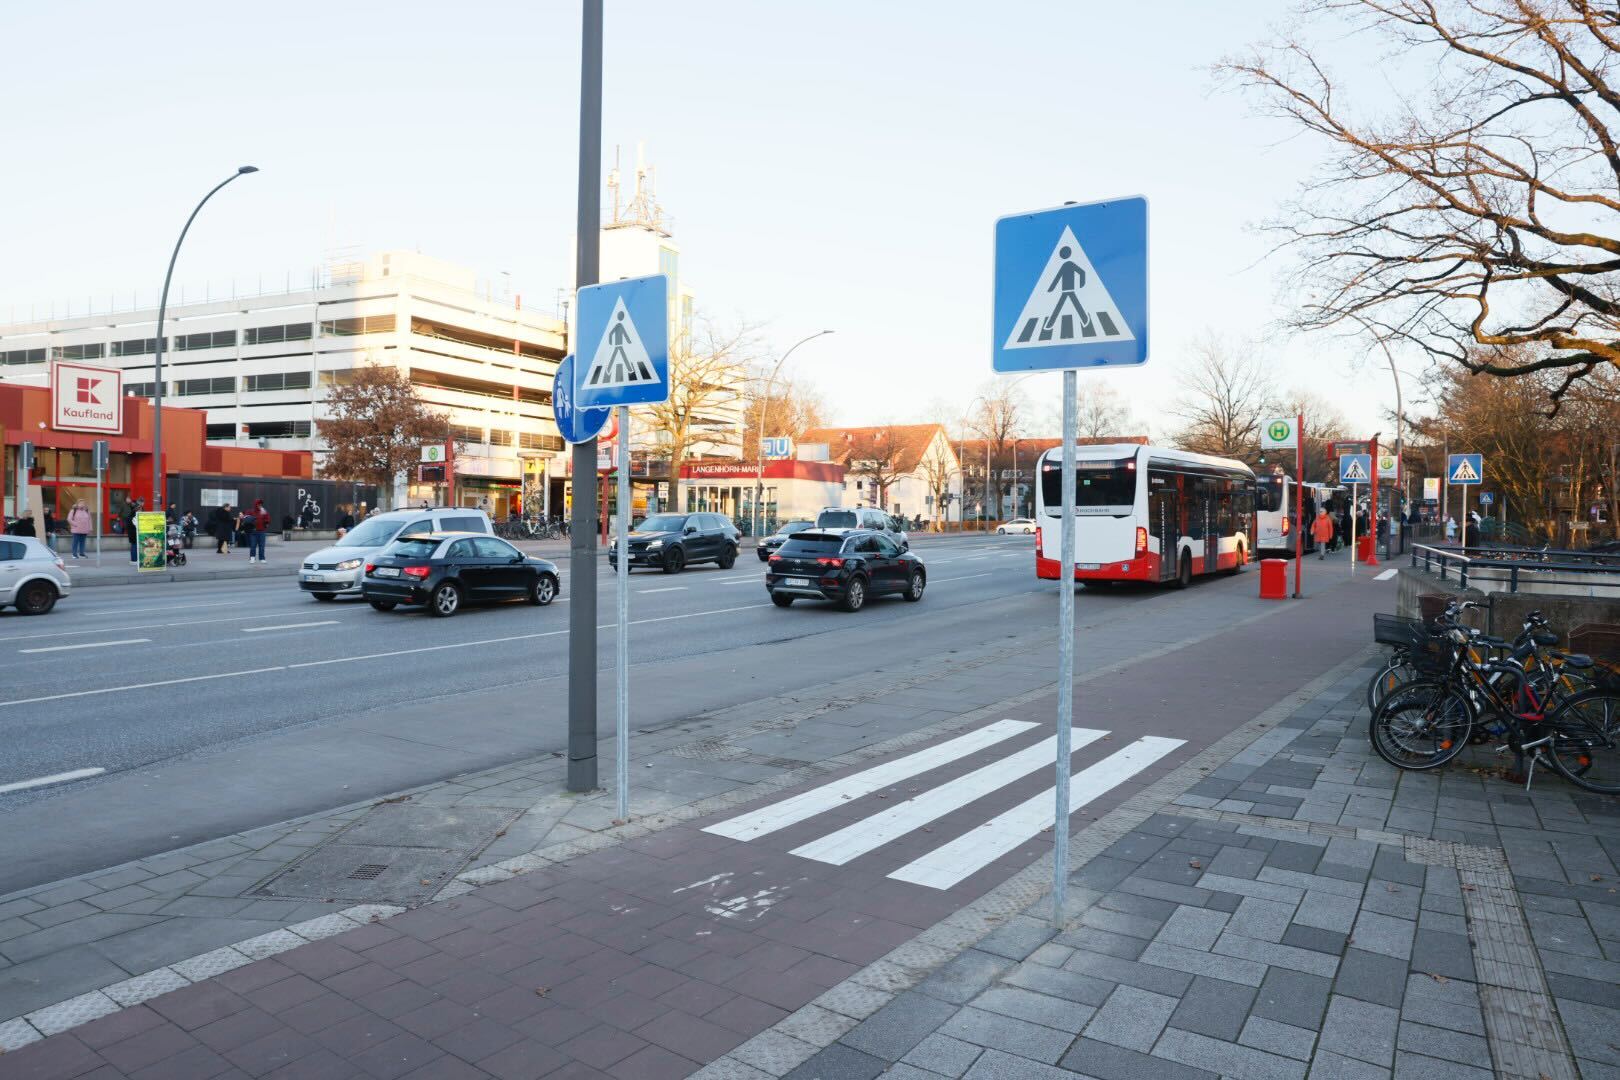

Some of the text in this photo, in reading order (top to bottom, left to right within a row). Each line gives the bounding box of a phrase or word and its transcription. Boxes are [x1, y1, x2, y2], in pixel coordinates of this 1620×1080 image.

[77, 377, 102, 404] K
[63, 407, 113, 420] Kaufland
[776, 438, 788, 455] U
[692, 465, 766, 473] LANGENHORN-MART
[298, 488, 306, 500] P
